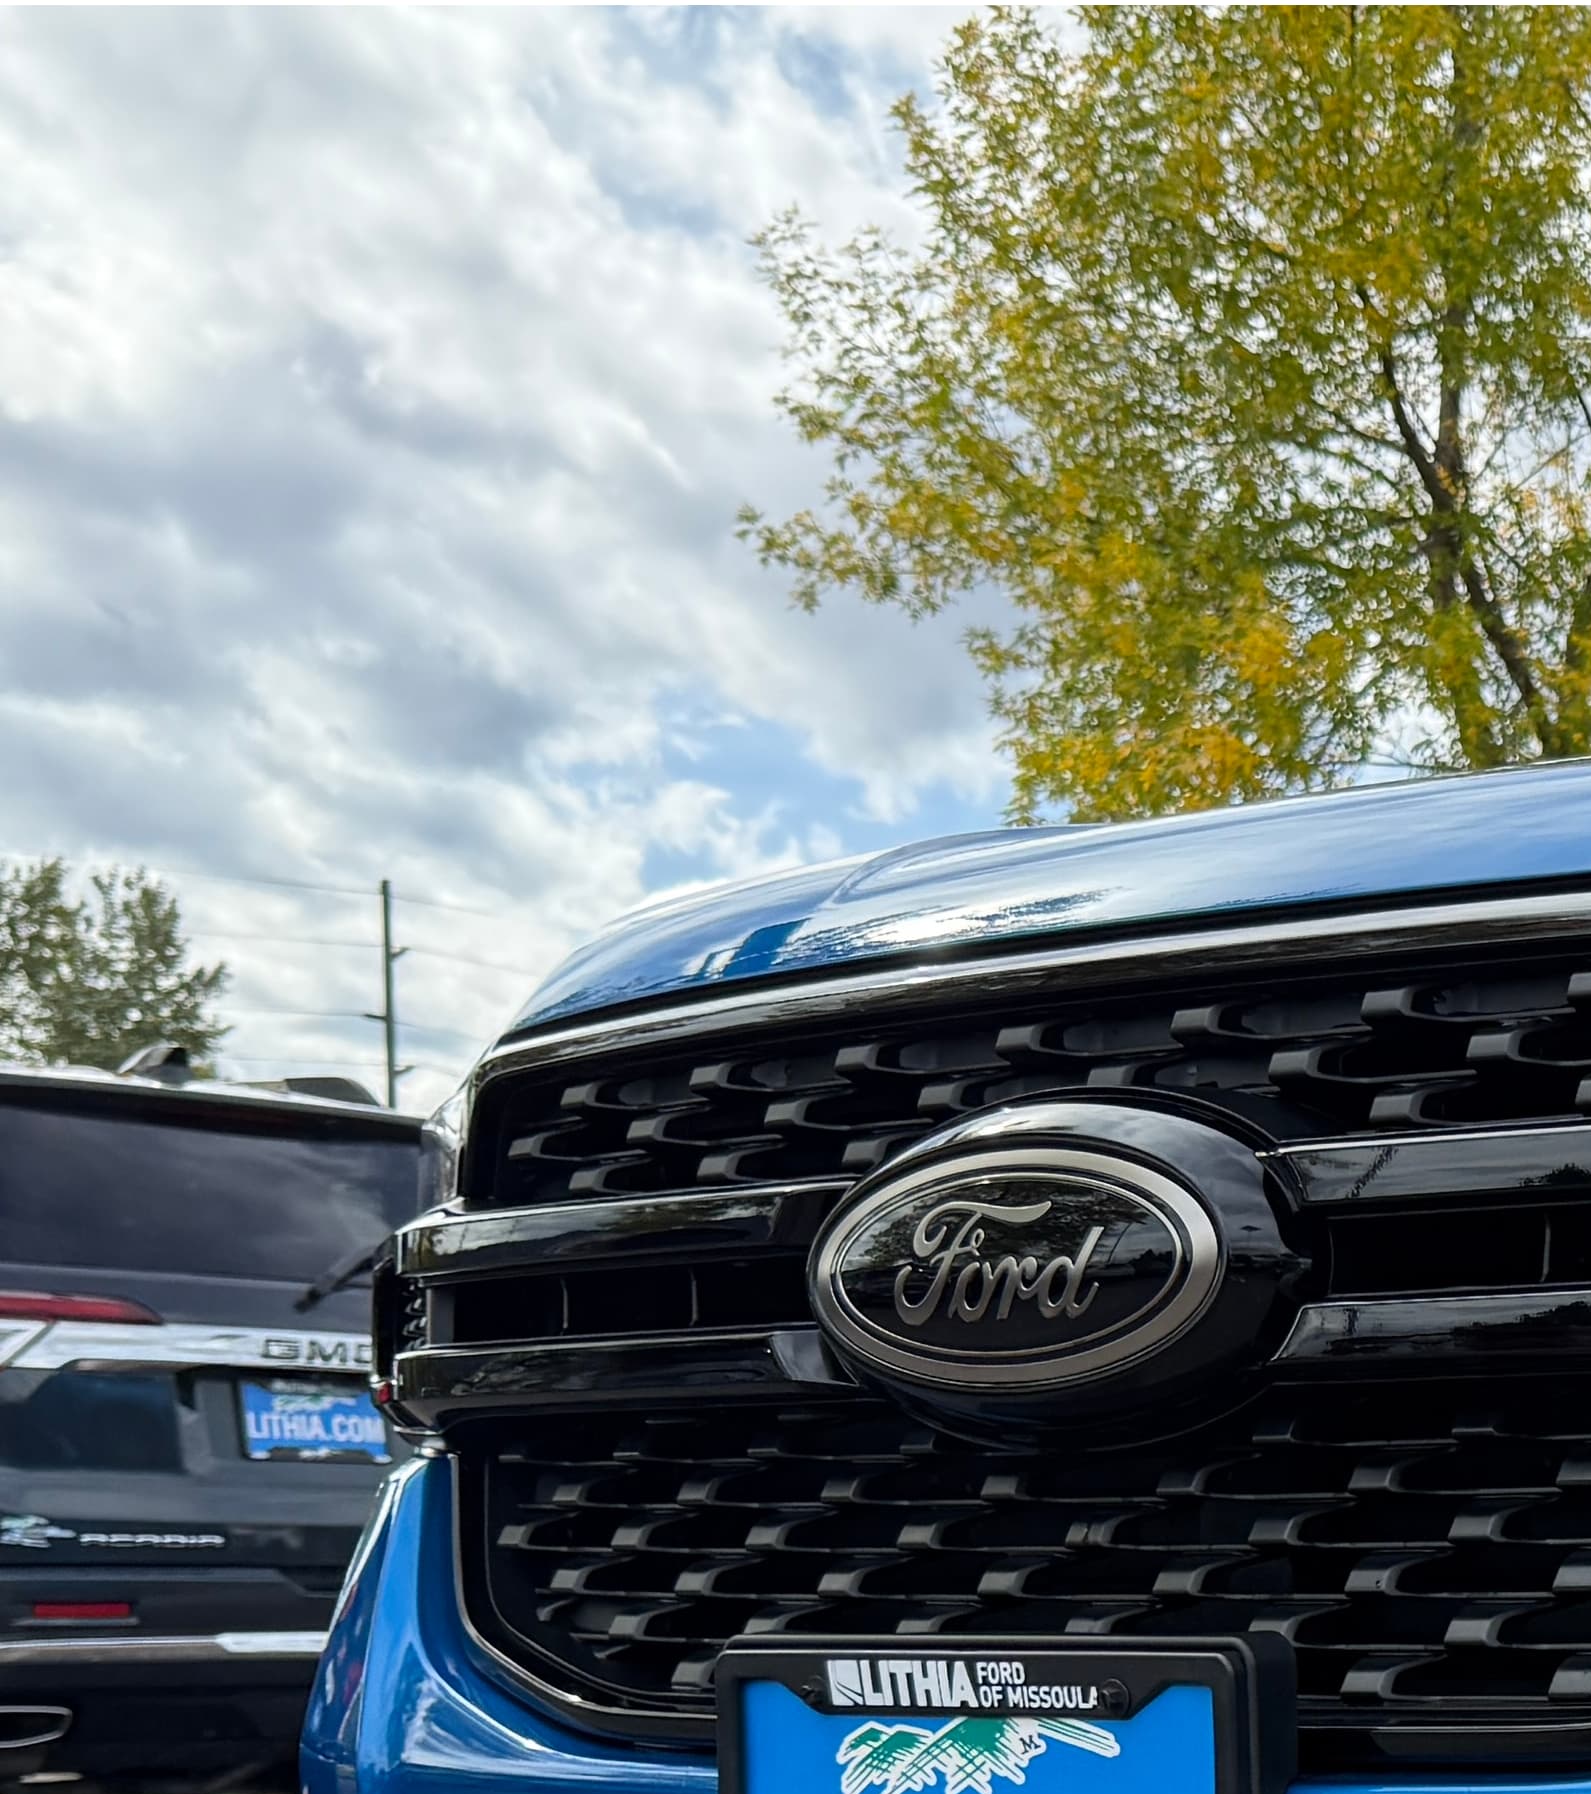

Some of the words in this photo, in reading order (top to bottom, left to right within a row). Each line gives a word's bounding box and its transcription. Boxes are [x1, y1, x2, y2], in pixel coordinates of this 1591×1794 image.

[895, 1200, 1105, 1326] Ford
[245, 1411, 387, 1444] LITHIA.COM
[859, 1659, 980, 1708] LITHIA
[976, 1661, 1026, 1685] FORD
[978, 1686, 1003, 1708] OF
[1007, 1685, 1098, 1709] MISSOULA
